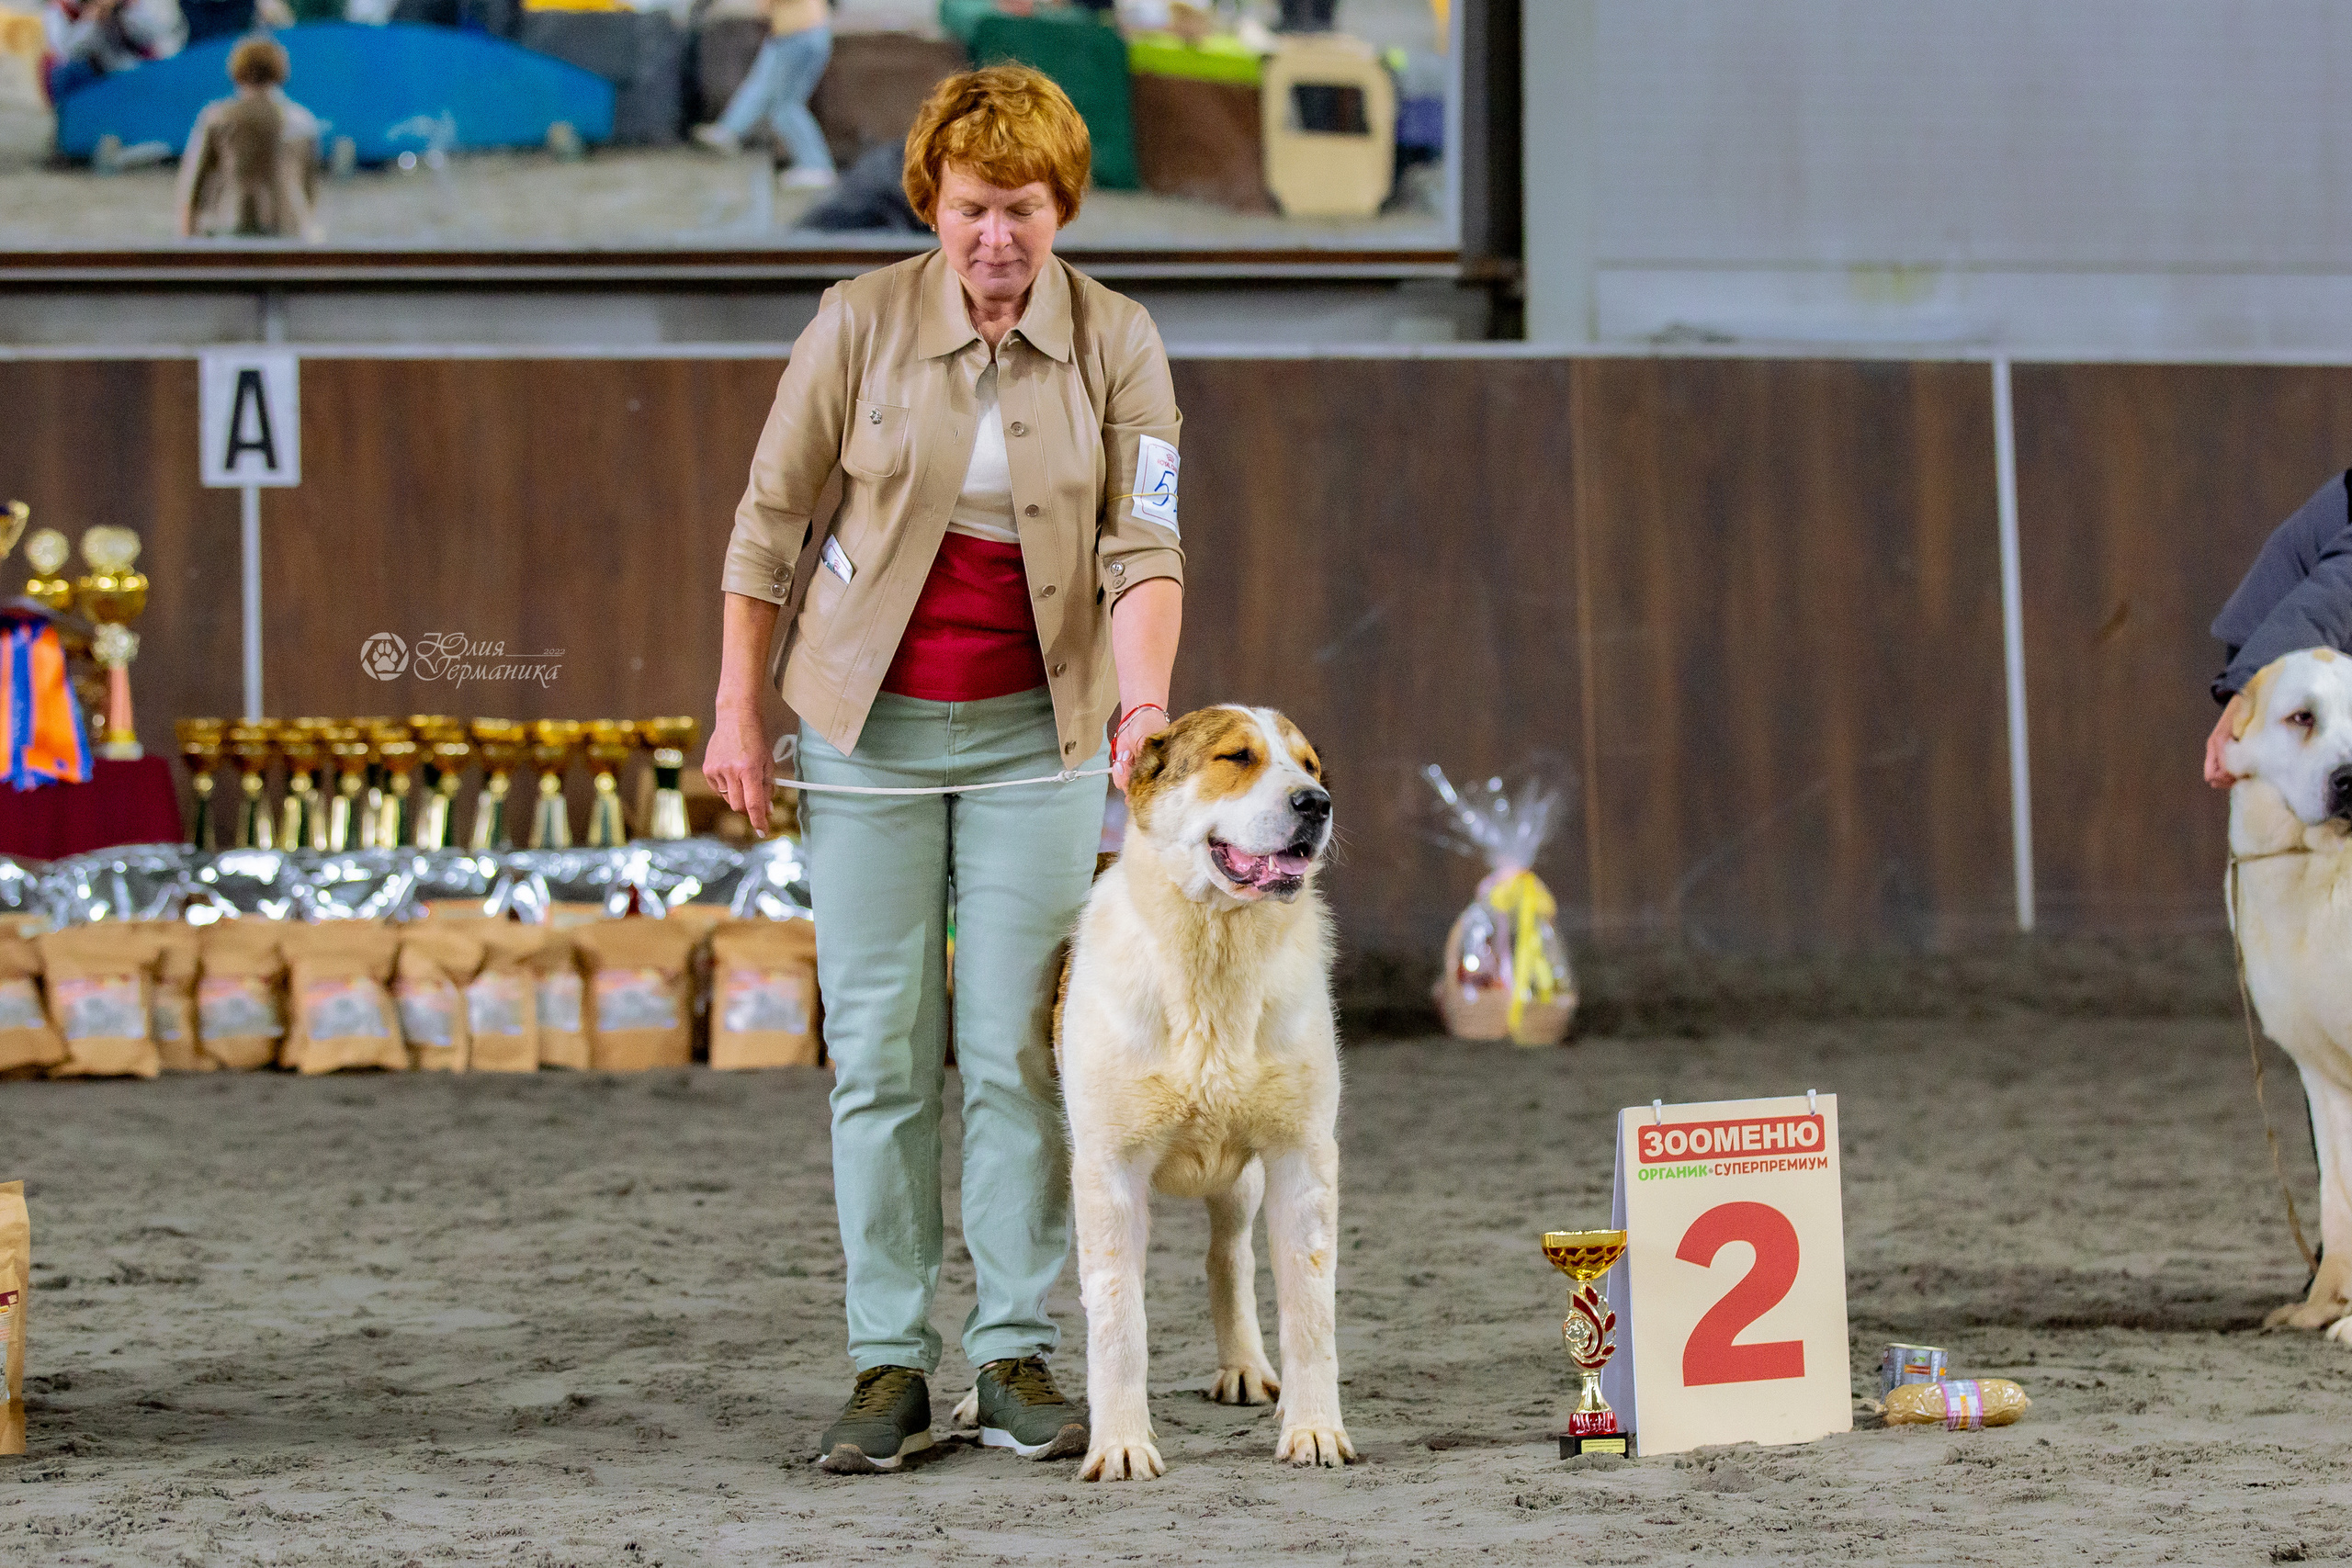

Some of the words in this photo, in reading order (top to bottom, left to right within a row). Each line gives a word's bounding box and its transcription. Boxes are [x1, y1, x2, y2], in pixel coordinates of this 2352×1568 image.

[224, 369, 277, 470] A
[1644, 1120, 1819, 1157] ЗООМЕНЮ
[1675, 1201, 1805, 1387] 2
